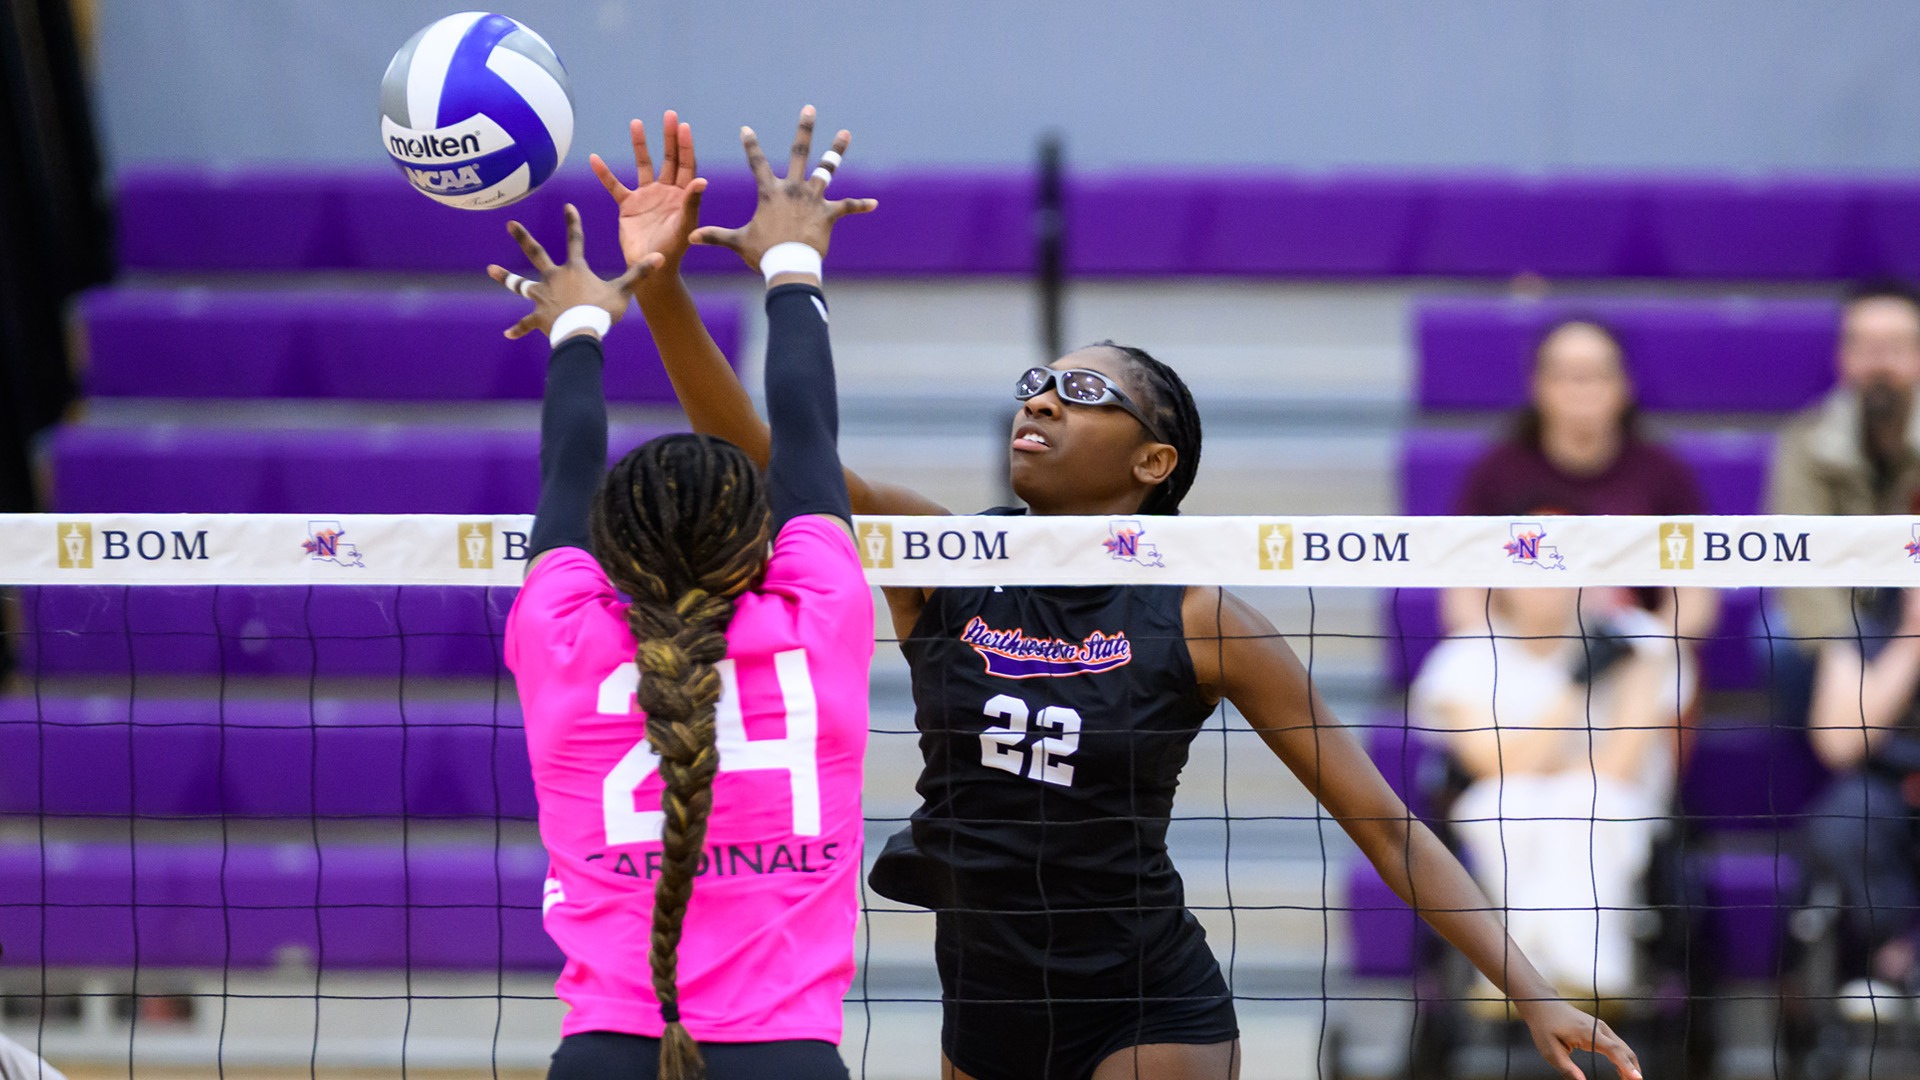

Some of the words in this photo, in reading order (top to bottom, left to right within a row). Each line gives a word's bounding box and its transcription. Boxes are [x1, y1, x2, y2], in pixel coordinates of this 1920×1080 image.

[390, 133, 480, 158] molten
[405, 165, 483, 190] NCAA
[102, 530, 209, 560] BOM
[902, 530, 1009, 560] BOM
[1303, 532, 1409, 562] BOM
[1703, 532, 1810, 562] BOM
[1080, 631, 1130, 662] State
[597, 648, 821, 846] 24
[979, 694, 1082, 787] 22
[585, 843, 838, 880] ARINALS
